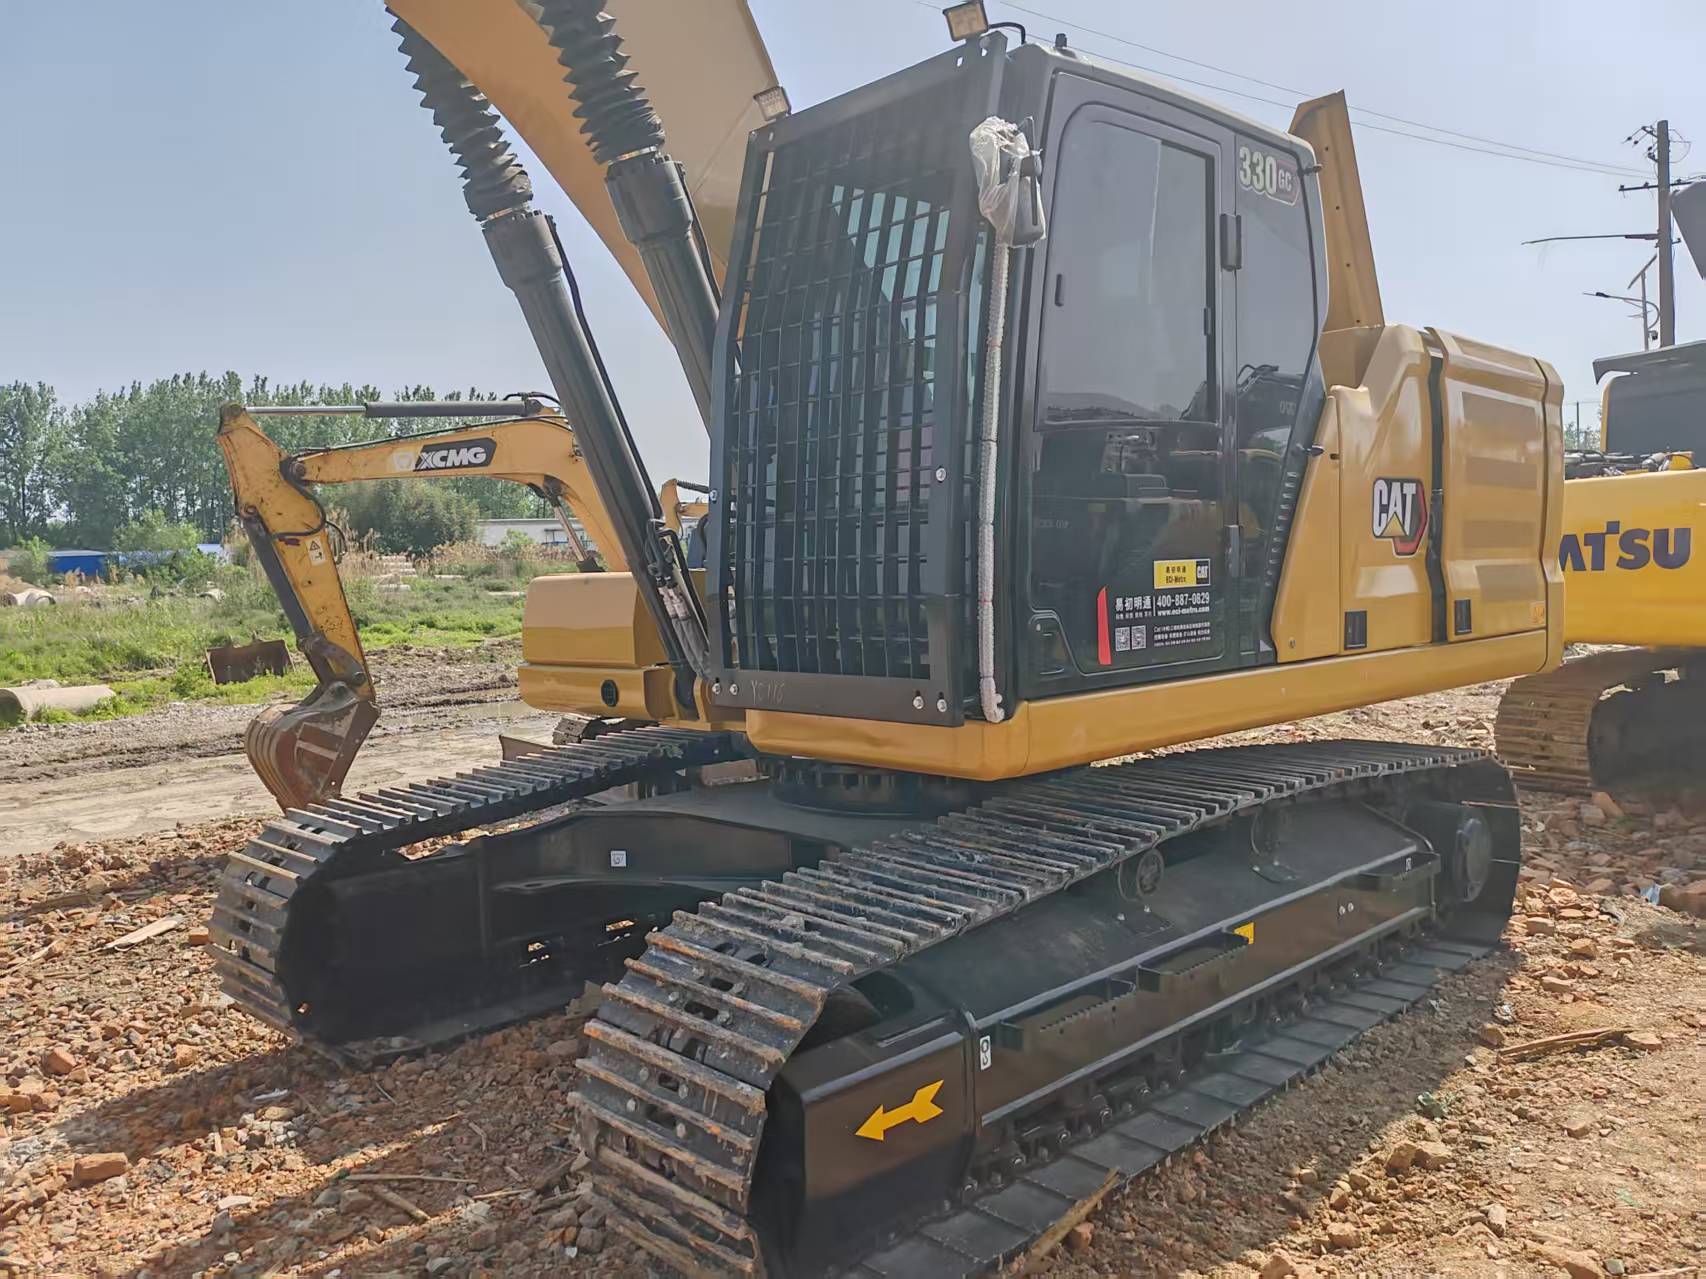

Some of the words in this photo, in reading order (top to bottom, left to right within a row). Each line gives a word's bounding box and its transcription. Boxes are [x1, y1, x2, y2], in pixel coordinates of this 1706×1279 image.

[1239, 146, 1277, 194] 330
[1278, 169, 1292, 192] GC
[417, 446, 487, 469] XCMG
[1373, 479, 1416, 537] CAT
[1558, 520, 1691, 572] ATSU
[1196, 565, 1209, 578] CAT
[1115, 595, 1152, 611] 易初明通
[1156, 591, 1210, 608] 400-887-0829
